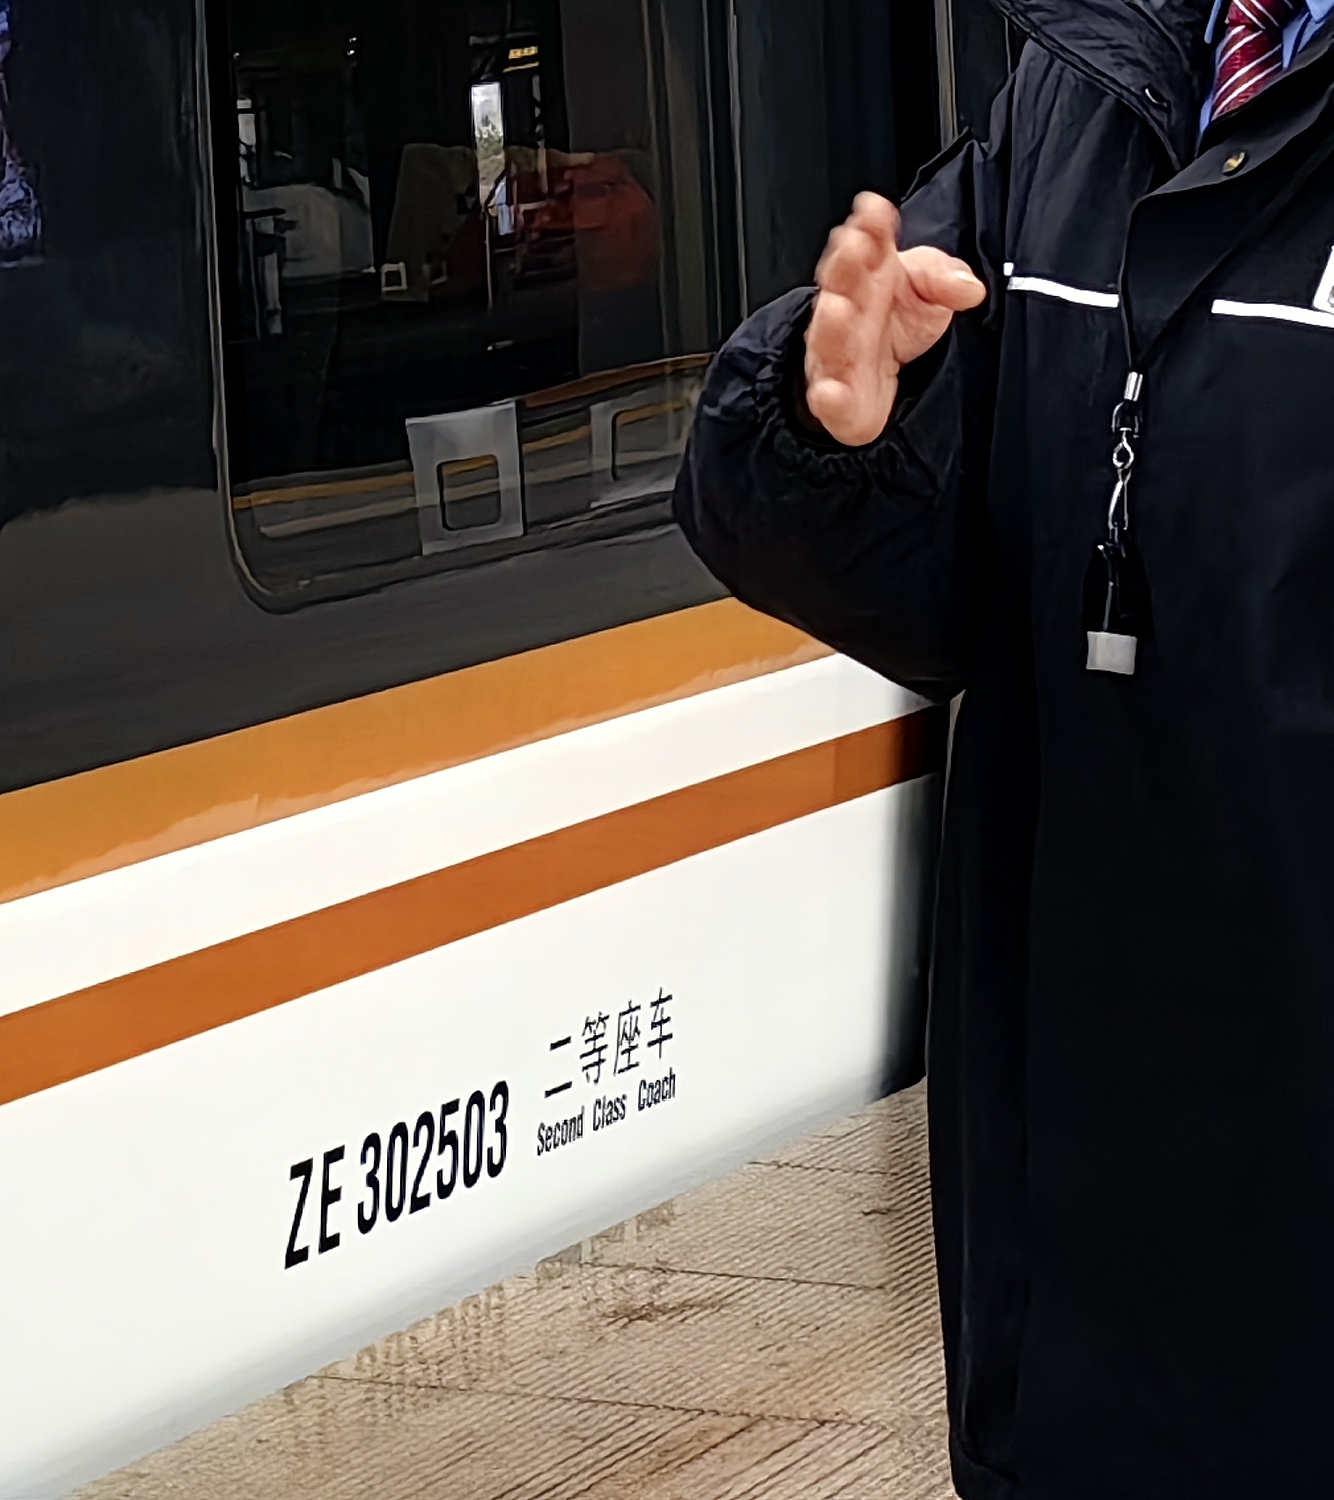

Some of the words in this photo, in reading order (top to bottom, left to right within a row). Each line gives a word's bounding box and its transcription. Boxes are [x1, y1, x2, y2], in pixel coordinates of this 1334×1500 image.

[544, 986, 674, 1099] 二等座车
[536, 1105, 585, 1157] Second
[592, 1093, 628, 1132] Class
[637, 1067, 676, 1112] Coach
[284, 1144, 346, 1270] ZE
[357, 1080, 510, 1235] 302503
